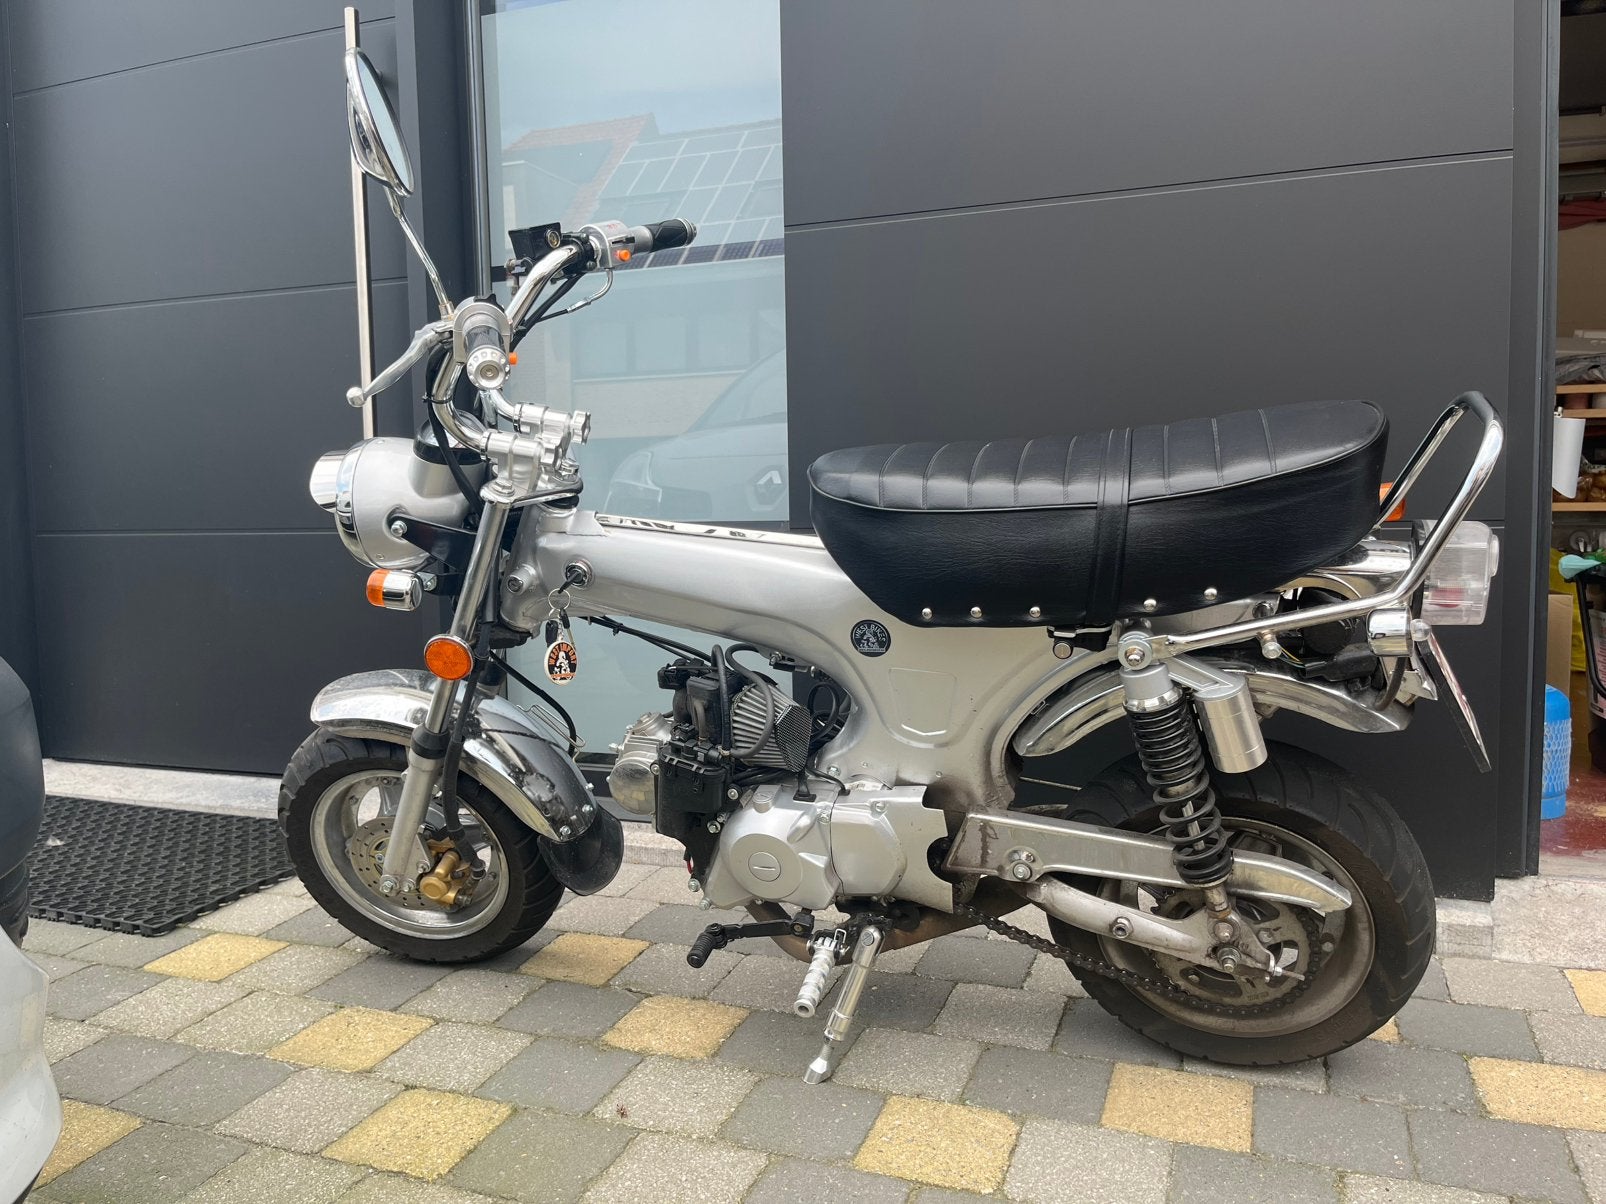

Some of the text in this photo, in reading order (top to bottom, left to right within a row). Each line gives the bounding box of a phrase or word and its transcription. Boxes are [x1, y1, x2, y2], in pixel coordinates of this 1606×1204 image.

[870, 624, 886, 642] BIKES
[548, 643, 577, 665] WEST IMPORT
